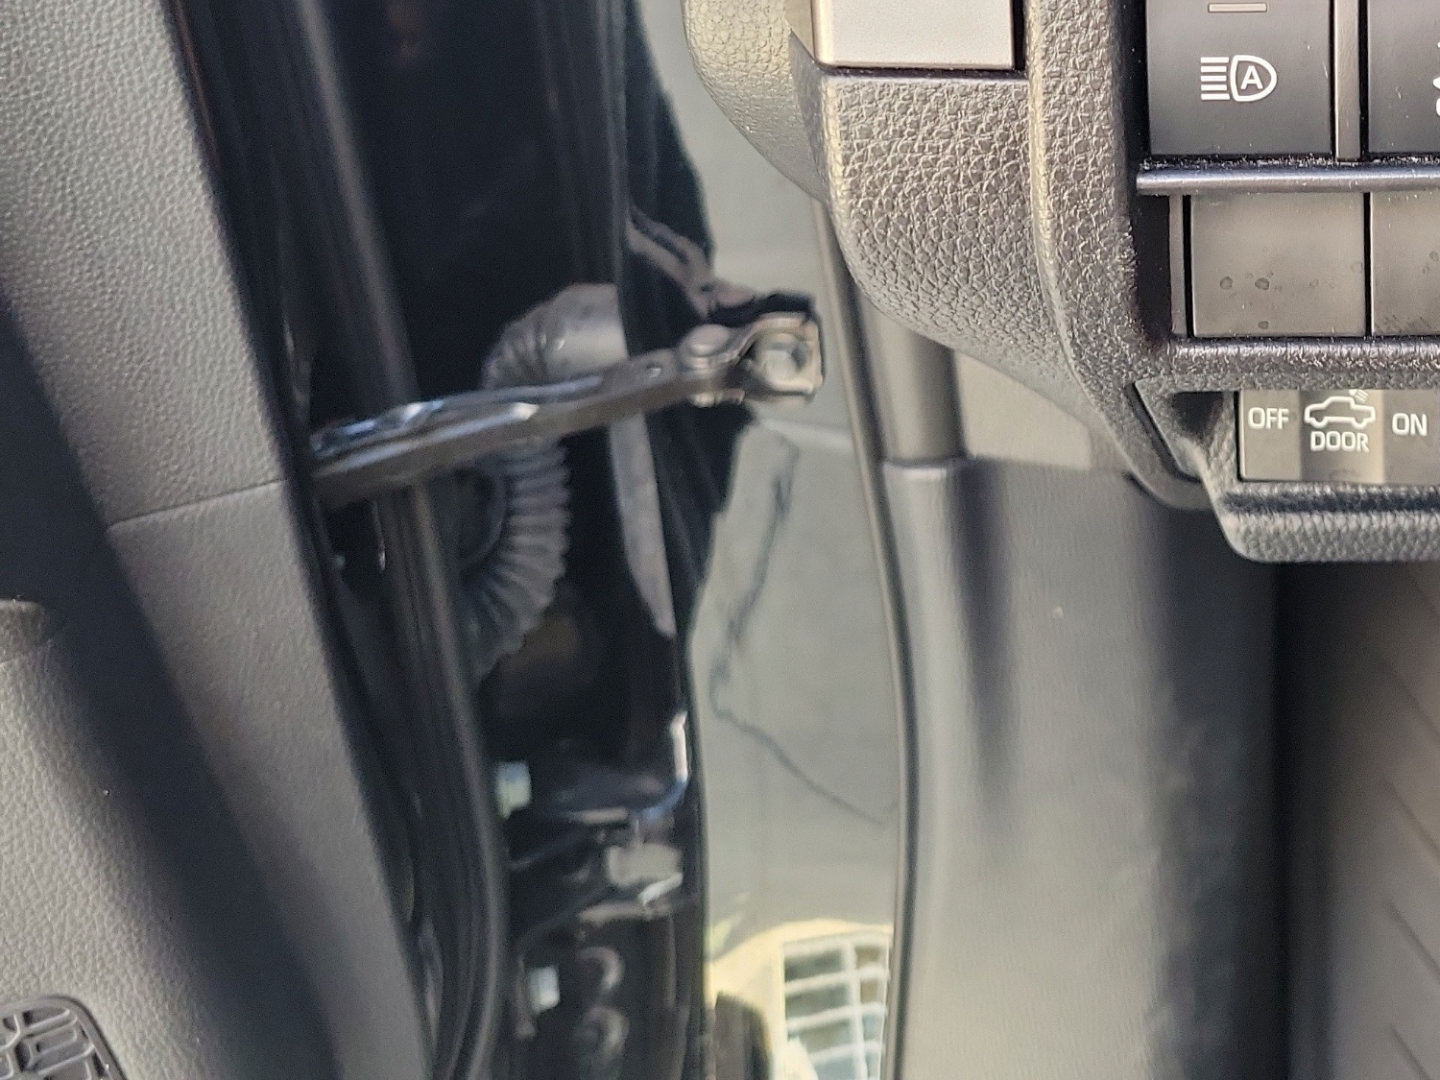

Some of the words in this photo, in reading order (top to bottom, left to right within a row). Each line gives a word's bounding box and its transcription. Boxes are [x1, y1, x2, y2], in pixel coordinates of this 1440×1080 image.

[1240, 65, 1264, 90] A
[1247, 407, 1289, 430] OFF
[1391, 413, 1428, 437] ON
[1310, 431, 1370, 453] DOOR
